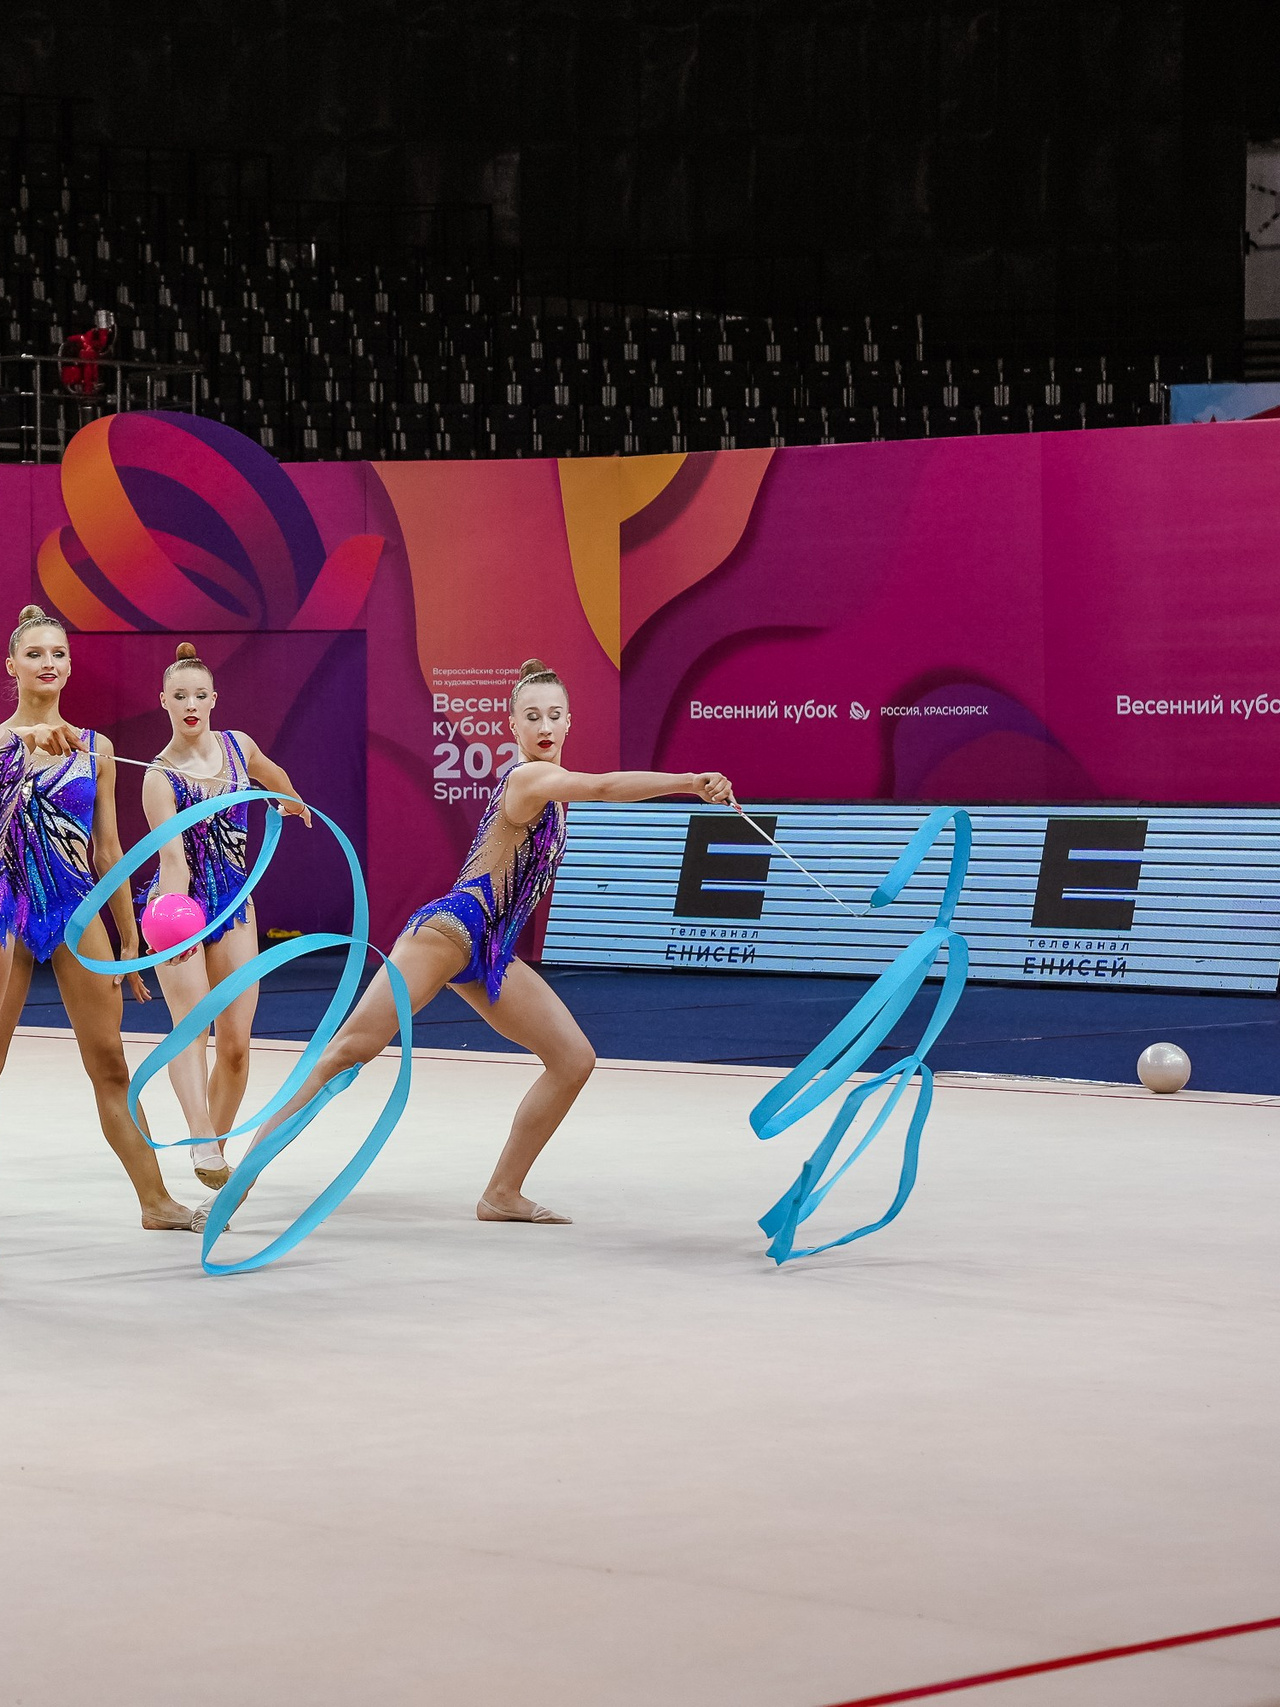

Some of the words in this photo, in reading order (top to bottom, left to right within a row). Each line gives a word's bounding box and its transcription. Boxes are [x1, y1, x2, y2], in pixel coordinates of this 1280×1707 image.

[432, 668, 494, 676] Всероссийские
[443, 679, 507, 687] художественной
[432, 693, 511, 713] Весен
[690, 700, 778, 719] Весенний
[784, 699, 838, 723] кубок
[880, 706, 922, 717] РОССИЯ,
[924, 705, 989, 716] КРАСНОЯРСК
[1116, 694, 1224, 715] Весенний
[1230, 693, 1280, 720] кубо
[432, 716, 504, 741] кубок
[433, 742, 519, 779] 202
[433, 782, 493, 805] Sprin
[670, 927, 759, 939] телеканал
[665, 944, 756, 964] ЕНИСЕЙ
[1028, 939, 1130, 951] телеканал
[1023, 956, 1127, 978] ЕНИСЕЙ
